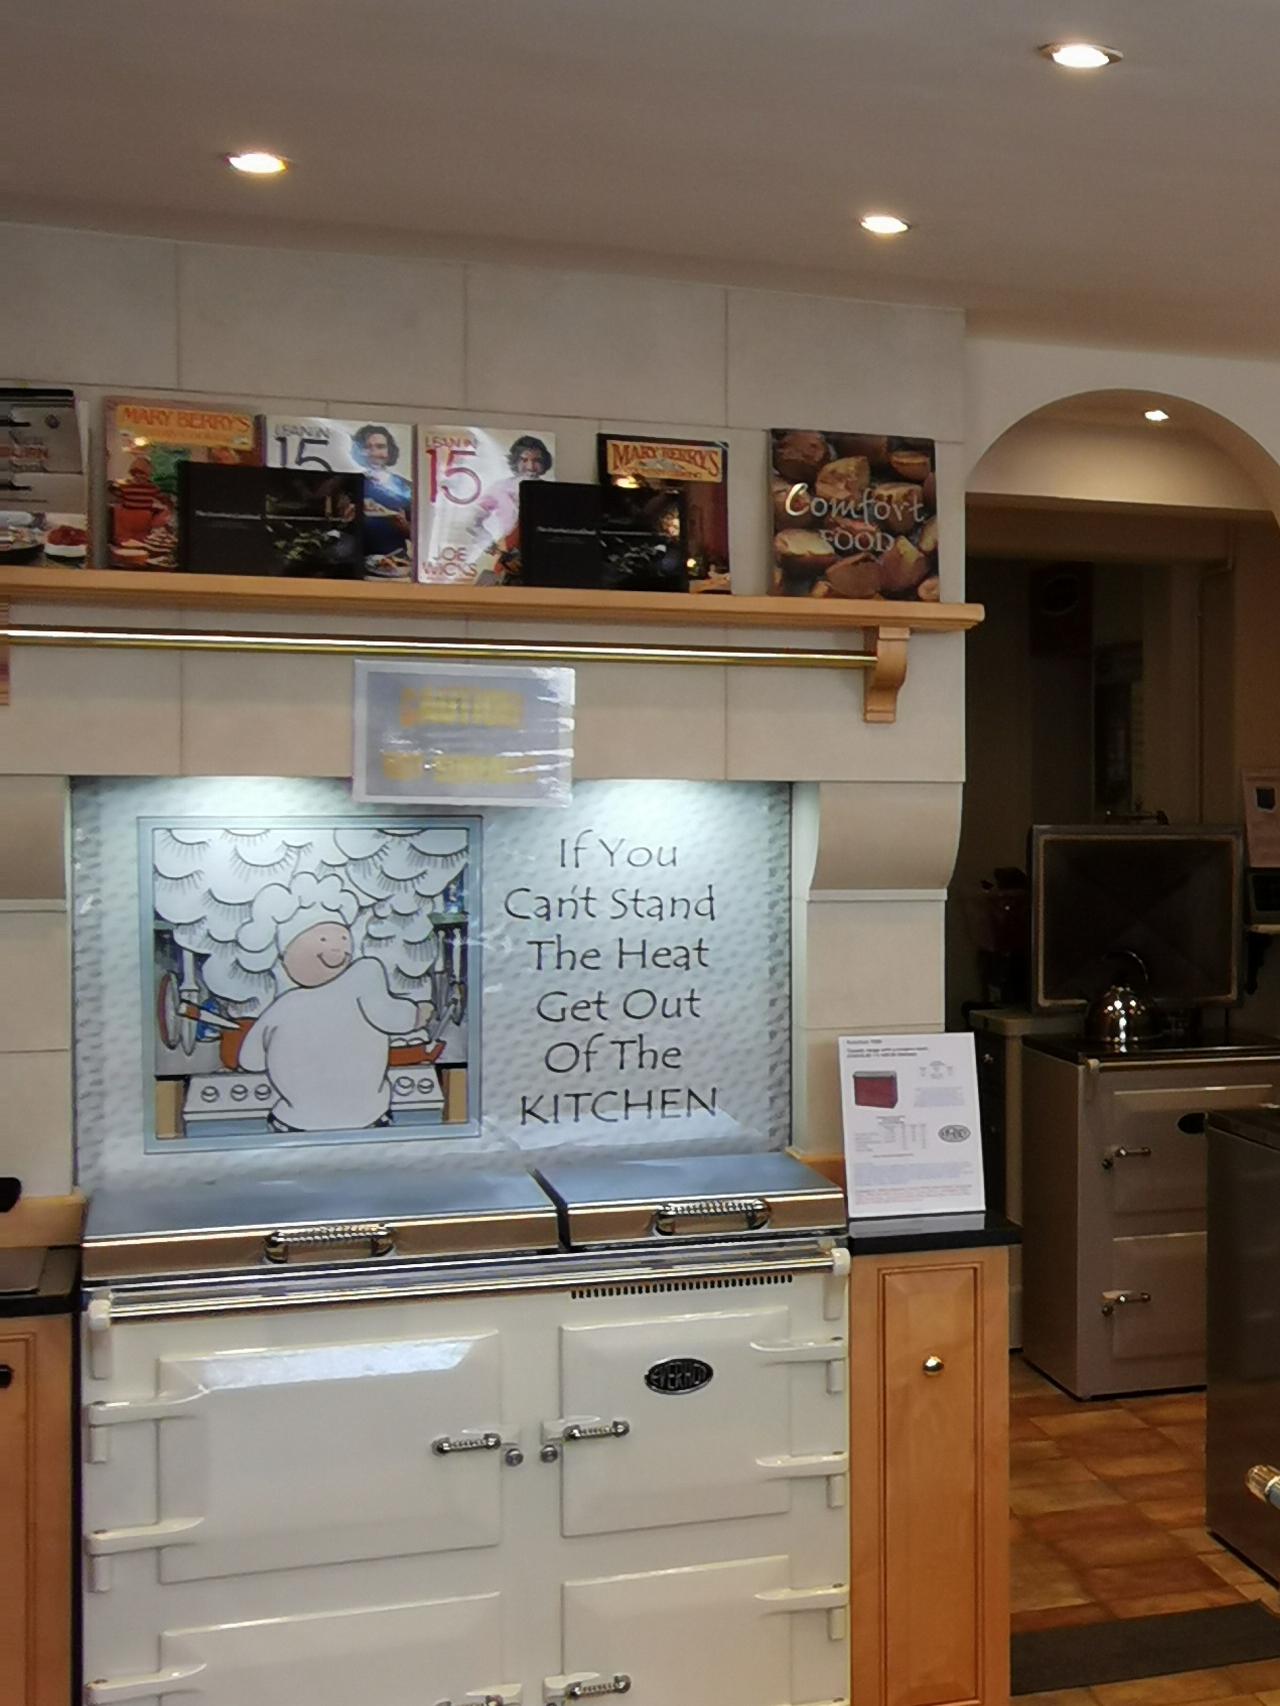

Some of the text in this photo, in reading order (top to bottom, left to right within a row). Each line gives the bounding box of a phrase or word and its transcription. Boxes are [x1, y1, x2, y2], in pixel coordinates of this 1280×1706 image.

[124, 406, 173, 427] MARY
[611, 444, 659, 471] MARY
[426, 449, 482, 505] 15
[785, 482, 924, 526] Comfort
[433, 547, 468, 561] JOE
[819, 529, 895, 552] FOOD
[421, 561, 478, 578] WICKS
[560, 829, 677, 868] If You
[504, 884, 715, 921] Can't Stand
[526, 934, 710, 971] The Heat
[536, 988, 701, 1022] Get Out
[545, 1033, 682, 1073] Of The
[520, 1087, 717, 1125] KITCHEN
